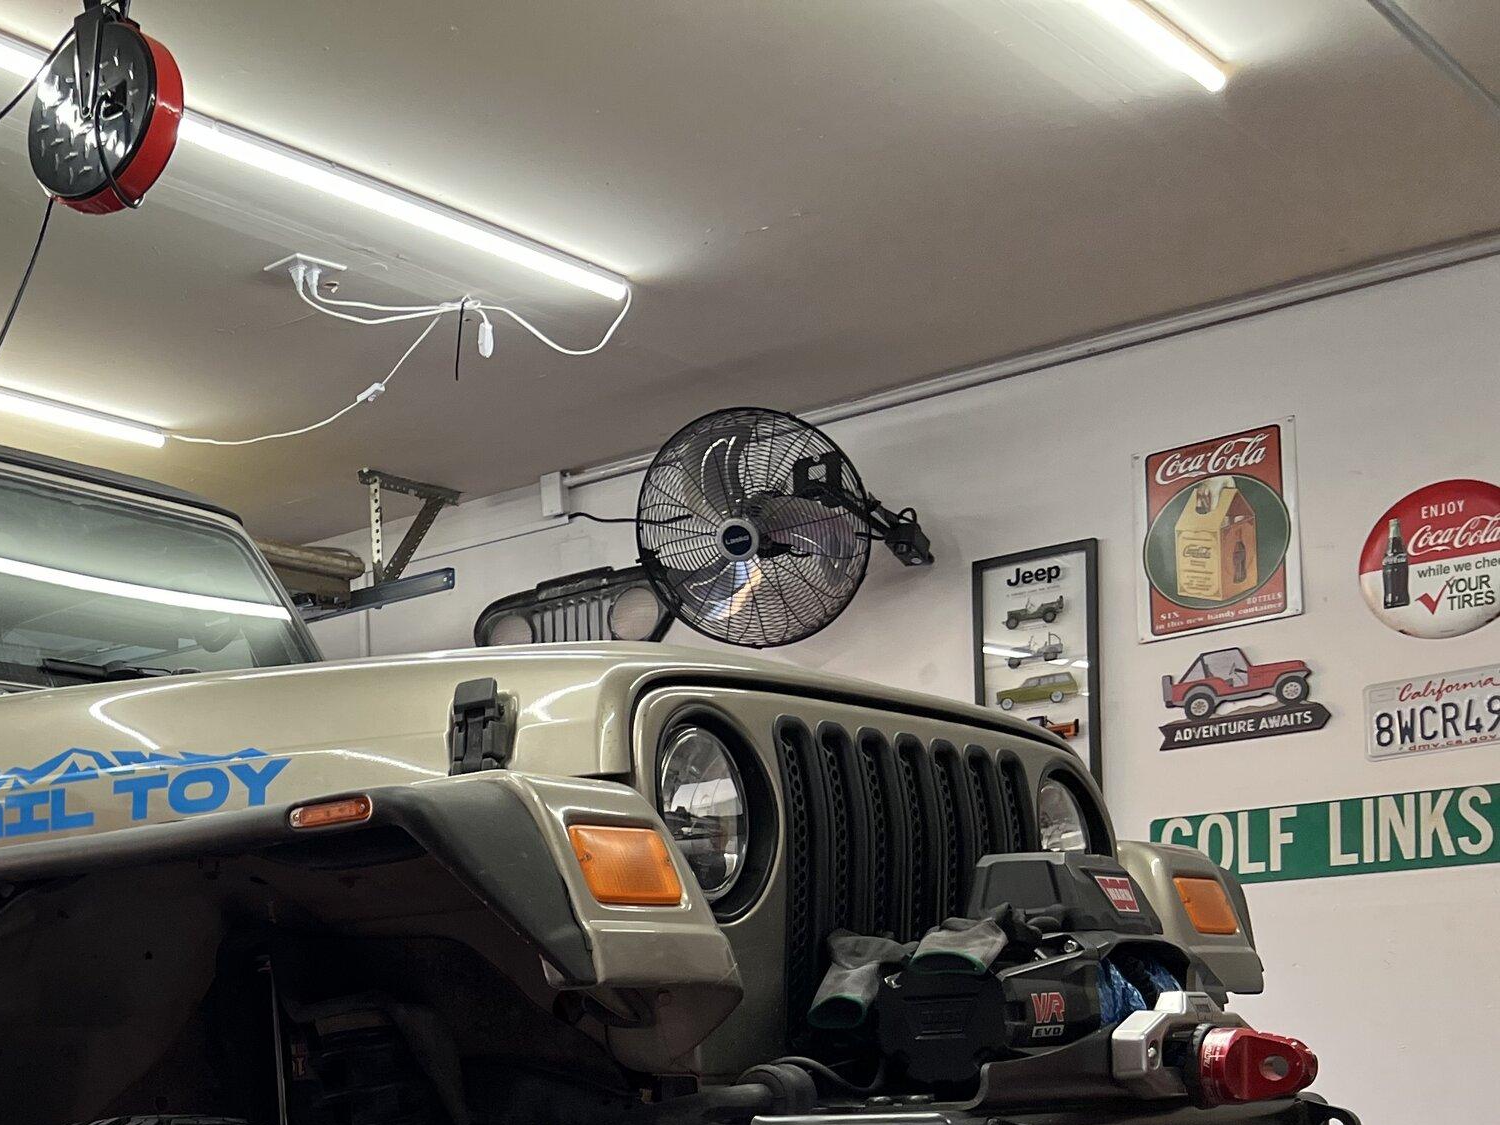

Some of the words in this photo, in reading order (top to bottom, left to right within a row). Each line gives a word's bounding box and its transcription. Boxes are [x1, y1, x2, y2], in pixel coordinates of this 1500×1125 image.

[1155, 433, 1270, 485] Coca-Cola
[1420, 499, 1465, 519] ENJOY
[1407, 514, 1500, 556] Coca-Cola
[1006, 564, 1061, 587] Jeep
[1417, 562, 1451, 579] while
[1454, 560, 1472, 574] we
[1446, 574, 1491, 595] YOUR
[1447, 590, 1496, 611] TIRES
[1160, 611, 1180, 621] SIX
[1167, 619, 1184, 629] this
[1186, 616, 1204, 624] new
[1207, 609, 1236, 622] handy
[1238, 601, 1283, 615] container
[1399, 677, 1500, 702] California
[1174, 718, 1255, 742] ADVENTURE
[1259, 710, 1313, 731] AWAITS
[1407, 733, 1498, 752] dmv.ca.gov
[112, 757, 292, 822] TOY
[1328, 785, 1495, 867] LINKS
[1030, 991, 1065, 1024] VR
[1034, 1025, 1063, 1037] EVO
